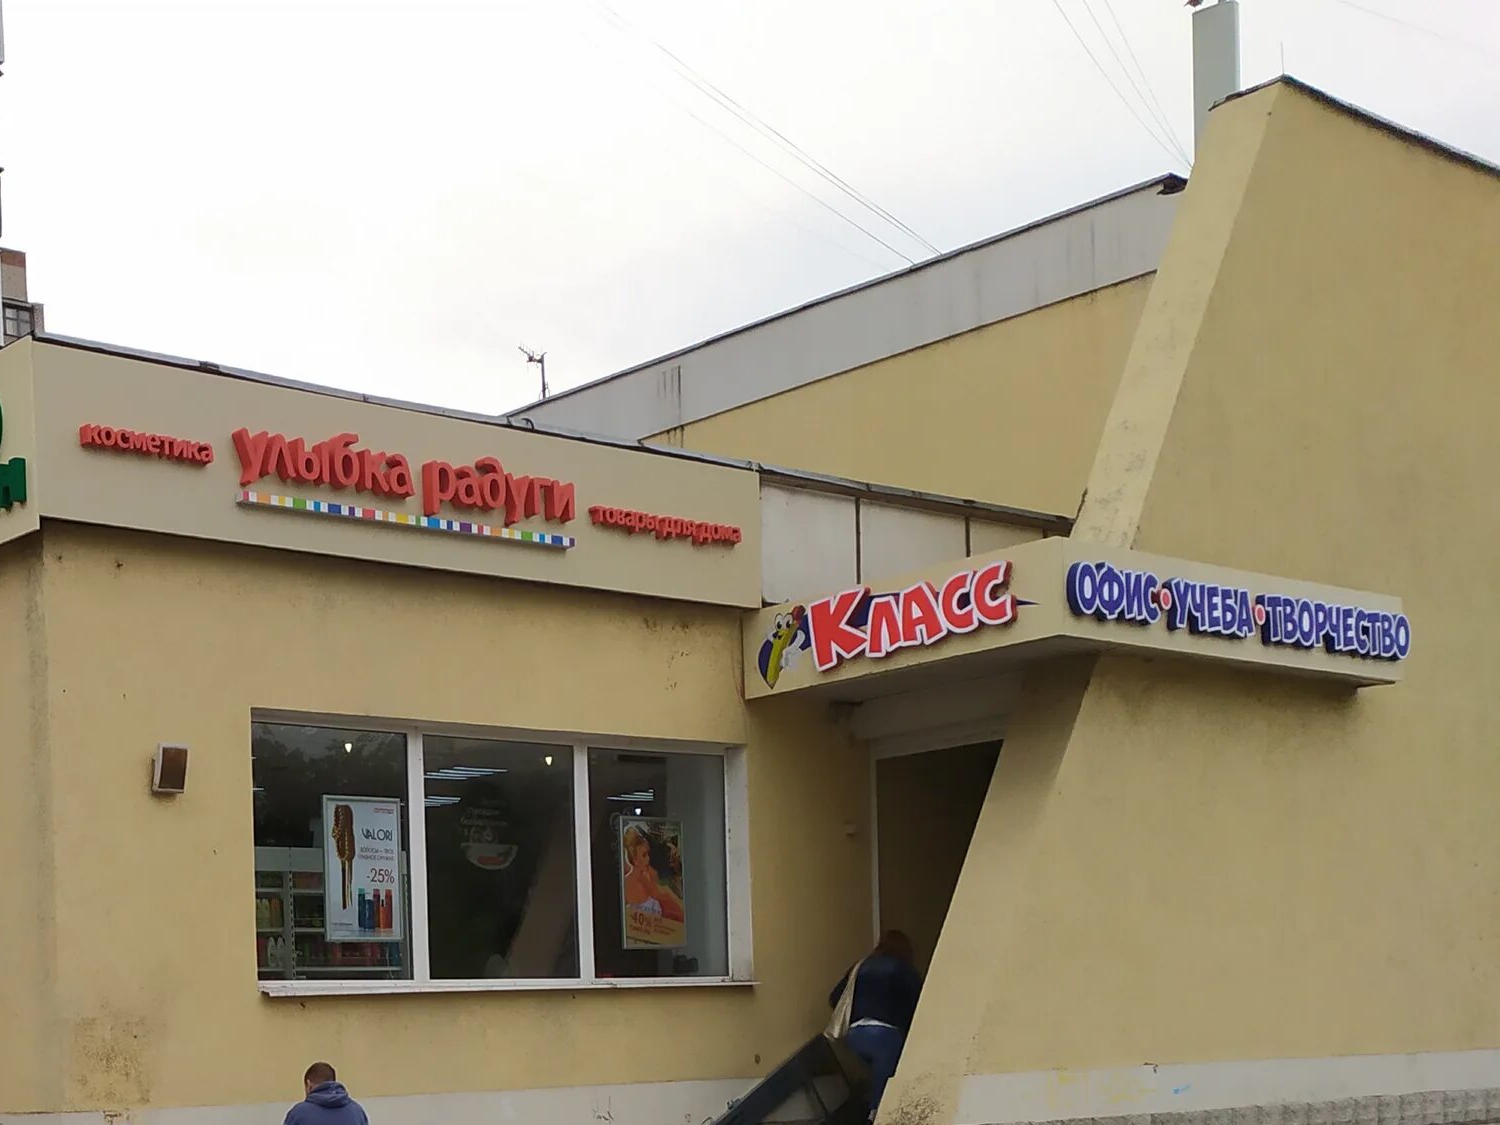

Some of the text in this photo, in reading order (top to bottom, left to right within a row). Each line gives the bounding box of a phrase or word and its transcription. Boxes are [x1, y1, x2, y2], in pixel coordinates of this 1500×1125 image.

[79, 422, 214, 464] косметика
[422, 456, 576, 527] радуги
[588, 505, 742, 545] товары для дома
[806, 560, 1018, 672] КЛАСС
[1067, 560, 1412, 662] ОФИС УЧЕБА ТВОРЧЕСТВО
[366, 867, 395, 884] -25%
